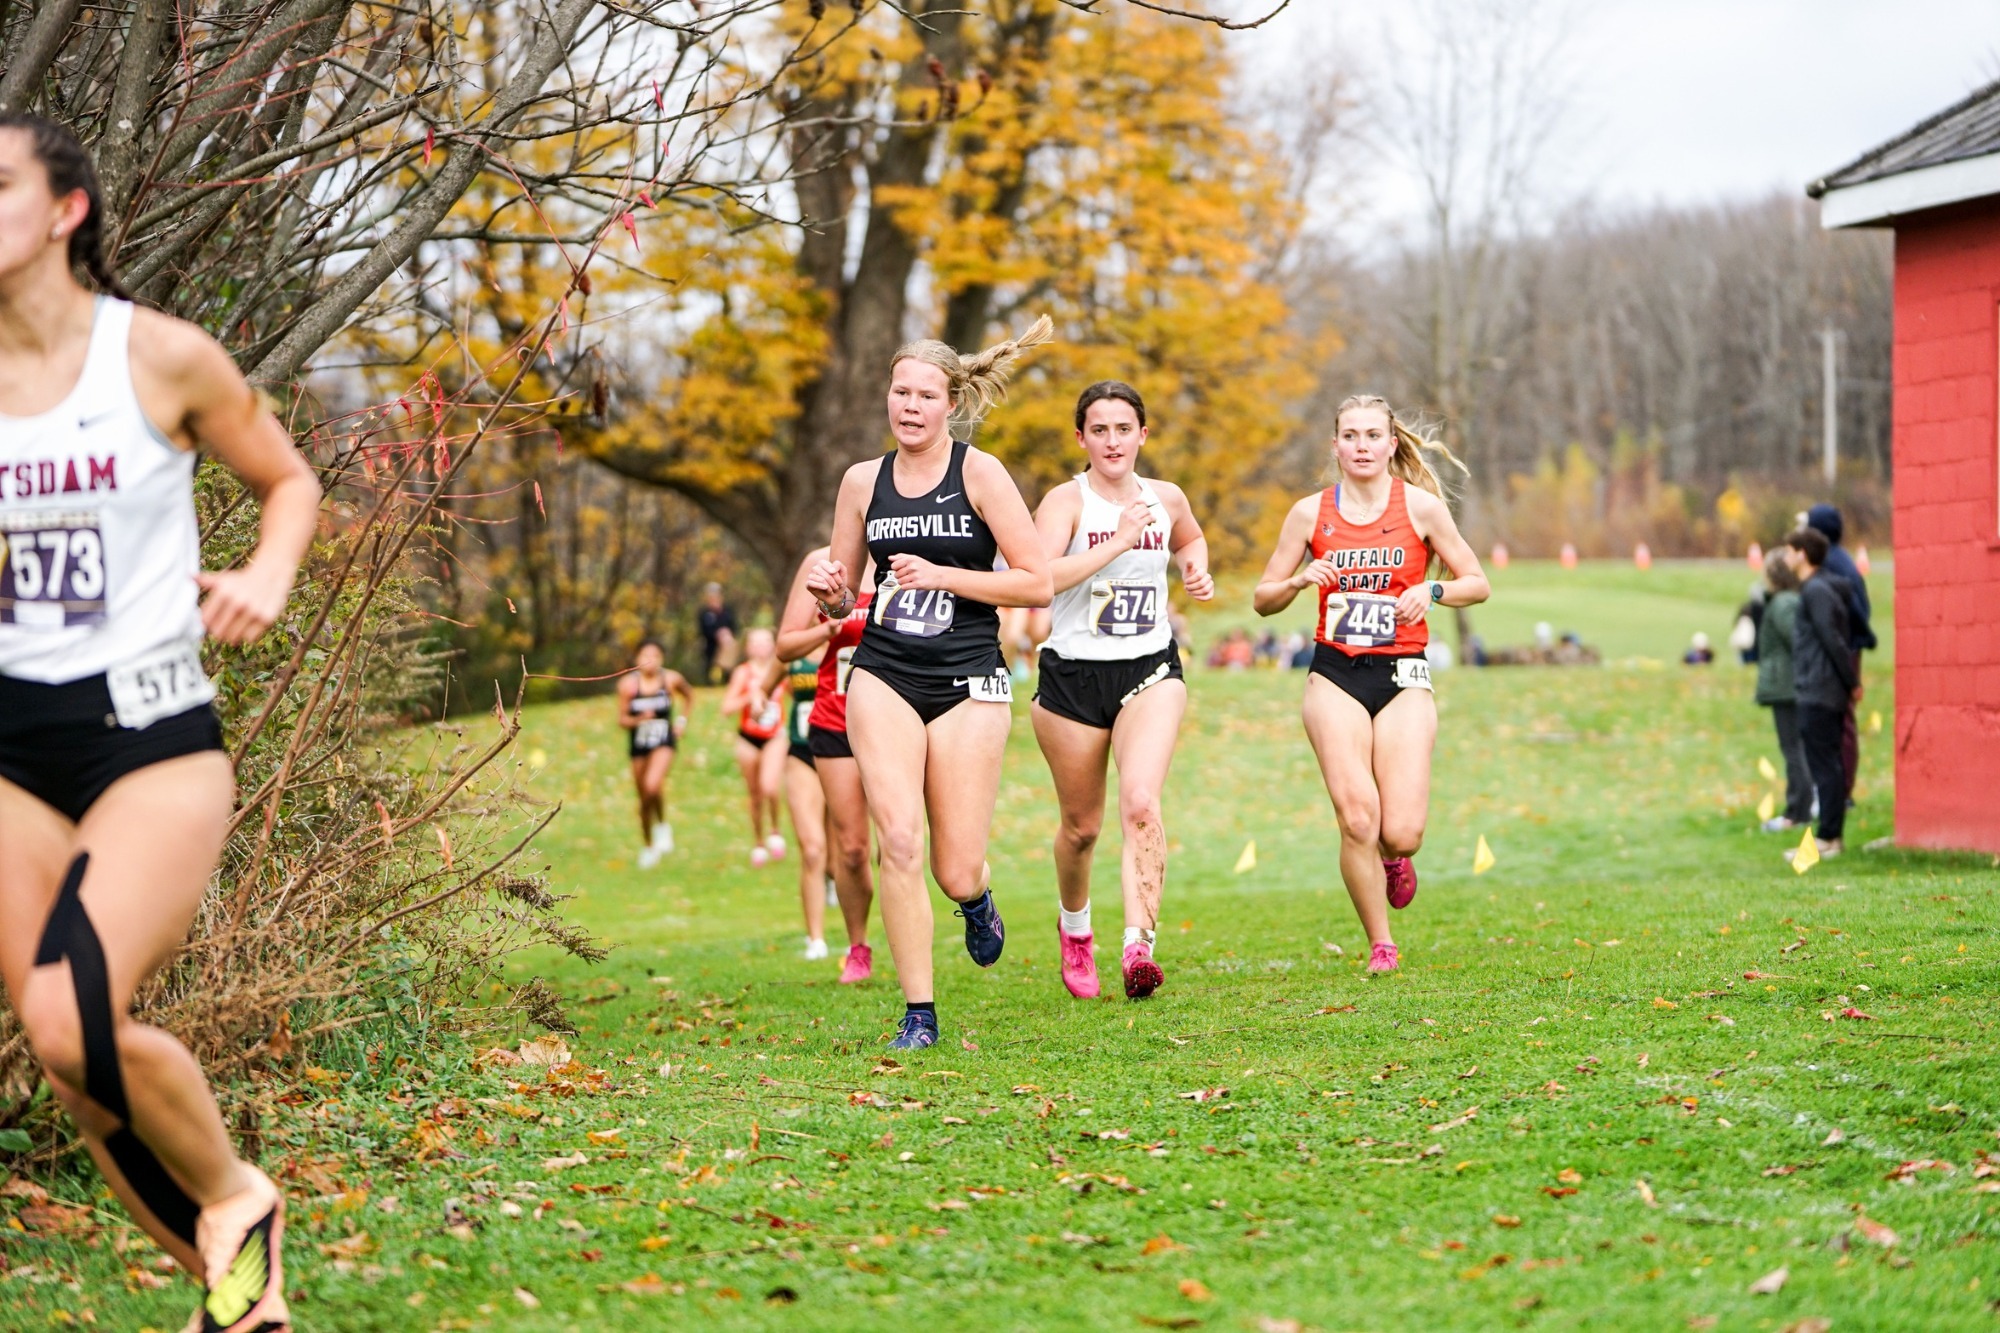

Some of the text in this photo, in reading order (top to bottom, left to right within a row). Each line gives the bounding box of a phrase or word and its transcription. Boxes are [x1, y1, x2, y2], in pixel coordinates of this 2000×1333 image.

[866, 514, 973, 543] MORRISVILLE
[1088, 531, 1163, 551] PODAM
[8, 529, 104, 600] 573
[1328, 547, 1404, 570] UFFALO
[1339, 573, 1391, 592] STATE
[1113, 589, 1156, 621] 574
[1347, 602, 1396, 635] 443
[981, 674, 1008, 695] 476
